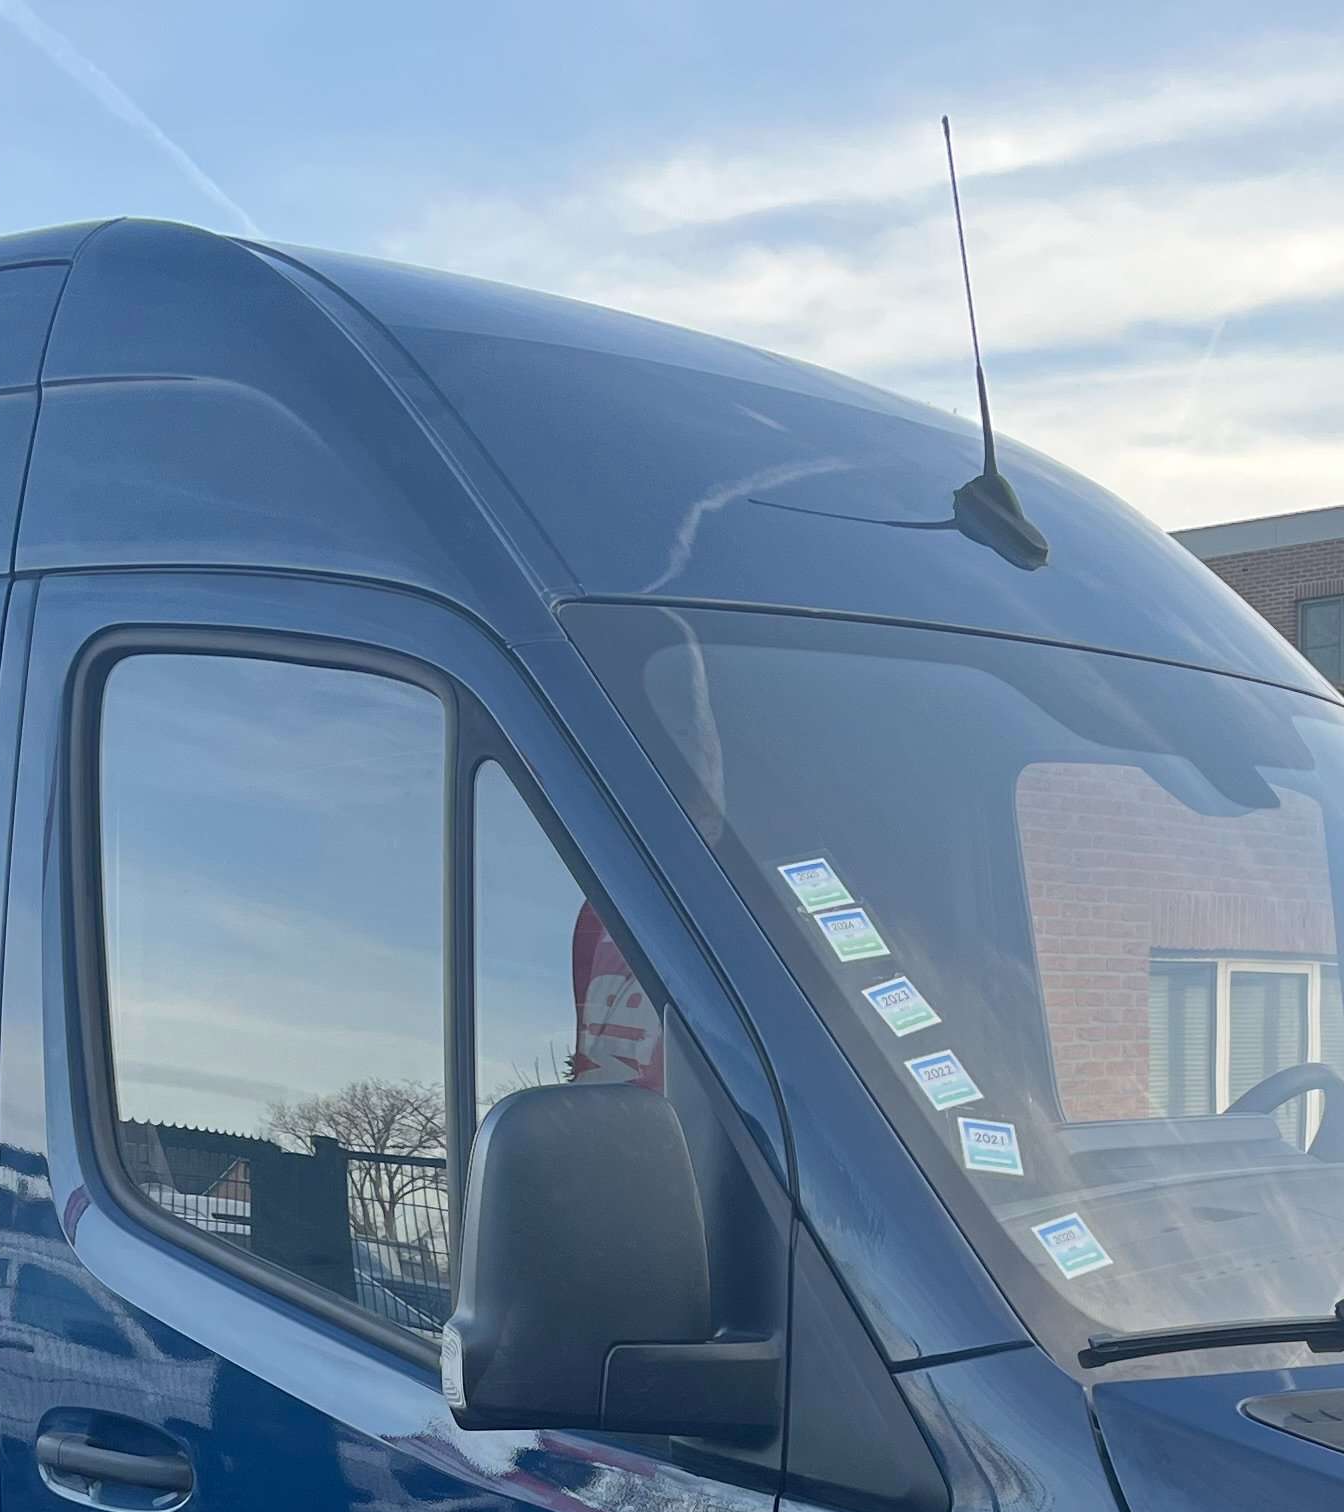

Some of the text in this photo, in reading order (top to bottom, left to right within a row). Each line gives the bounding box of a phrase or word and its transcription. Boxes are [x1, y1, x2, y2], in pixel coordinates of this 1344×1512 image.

[881, 989, 910, 1007] 2023
[924, 1064, 954, 1081] 2022
[973, 1131, 1005, 1146] 2021
